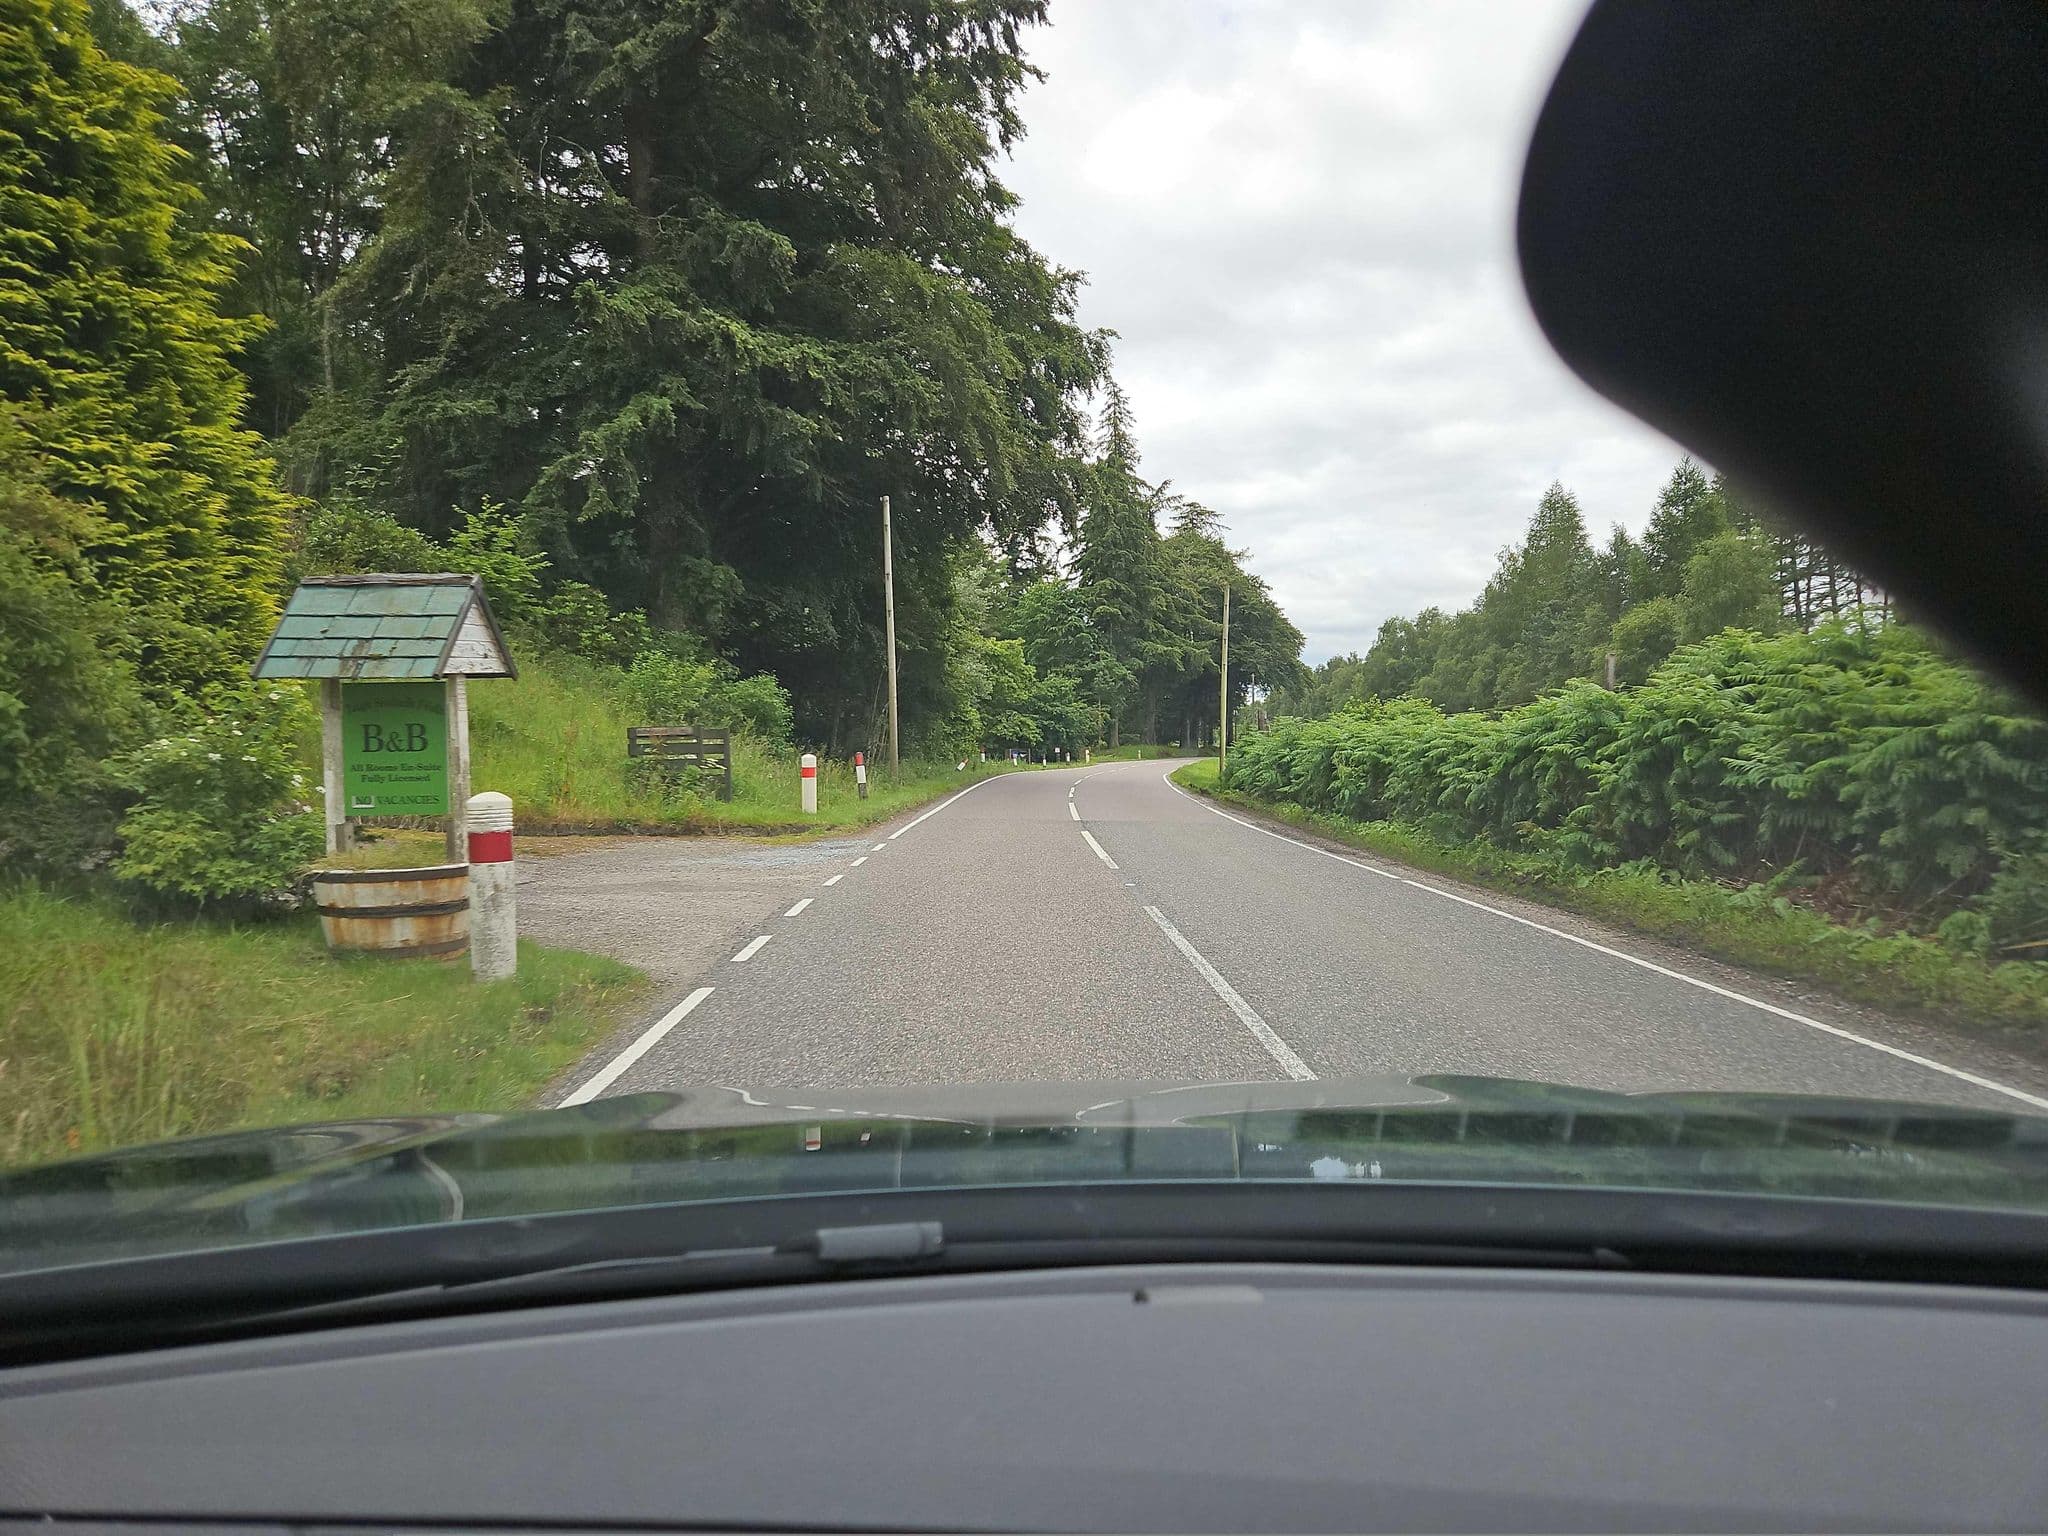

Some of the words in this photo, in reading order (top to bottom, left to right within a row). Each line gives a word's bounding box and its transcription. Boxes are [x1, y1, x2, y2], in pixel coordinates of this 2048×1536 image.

[361, 723, 429, 753] B&B
[351, 764, 363, 772] All
[366, 764, 398, 772] Rooms
[361, 774, 385, 783] Fully
[388, 774, 431, 782] Licensed
[375, 795, 440, 805] VACANCIES
